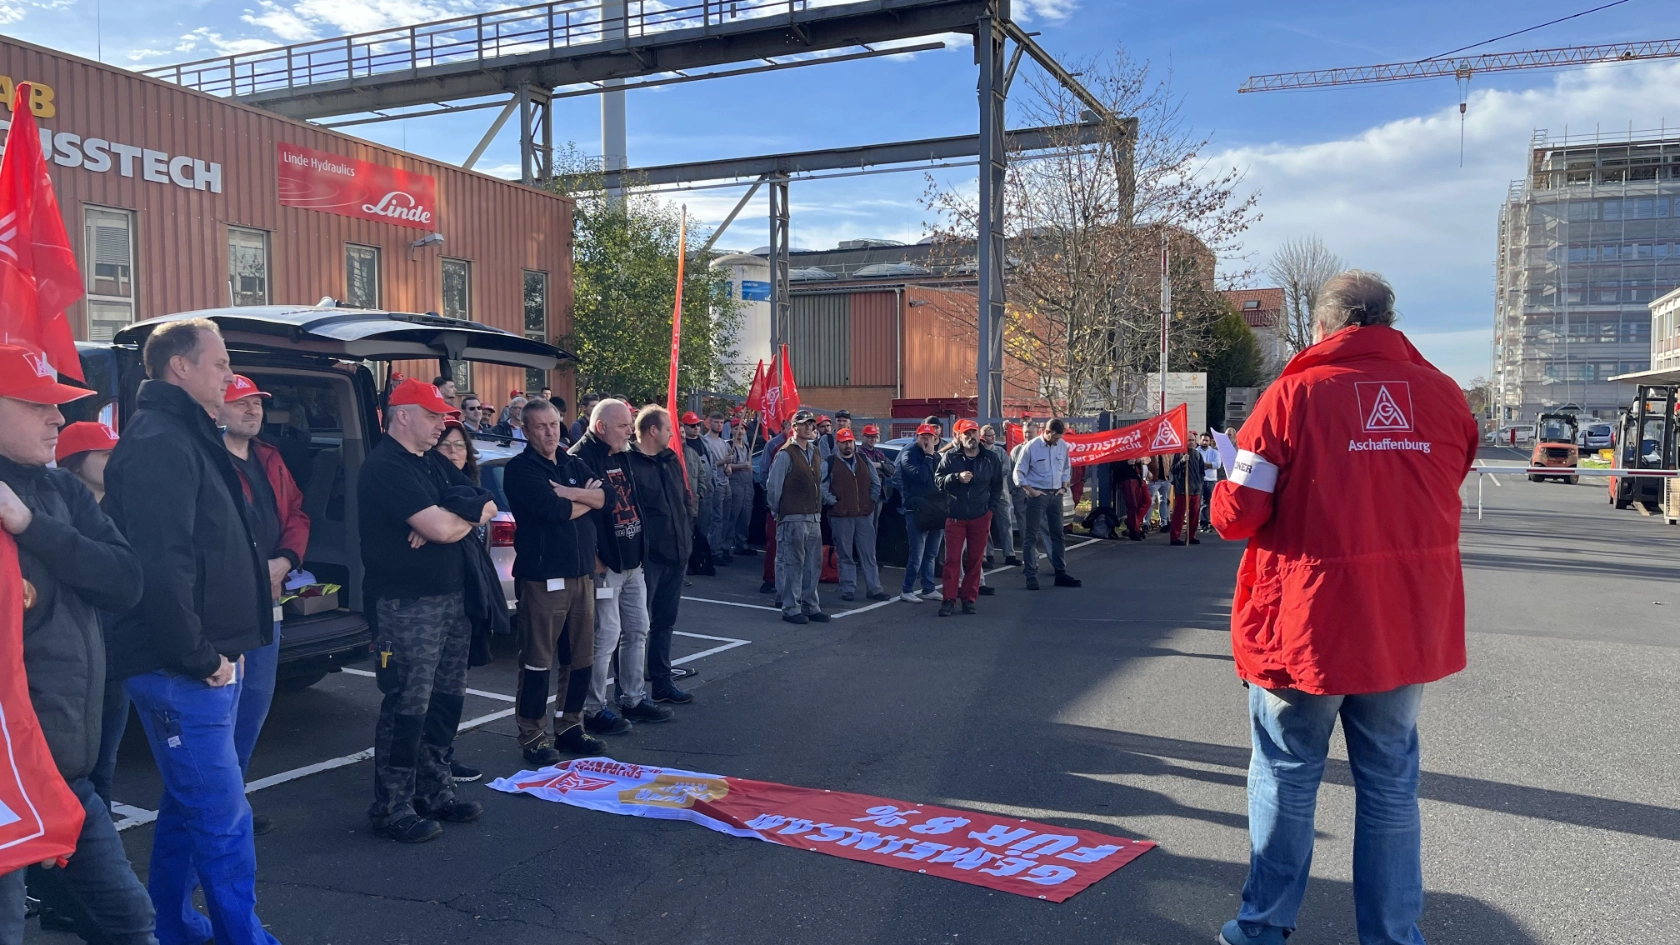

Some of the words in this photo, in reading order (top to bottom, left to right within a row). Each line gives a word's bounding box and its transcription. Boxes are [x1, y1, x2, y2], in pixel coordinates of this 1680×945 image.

[283, 151, 309, 167] Linde
[310, 157, 355, 177] Hydraulics
[361, 191, 431, 224] Linde
[1348, 438, 1431, 454] Aschaffenburg
[744, 812, 1077, 886] GEMEINSAM
[967, 828, 1124, 863] FÜR
